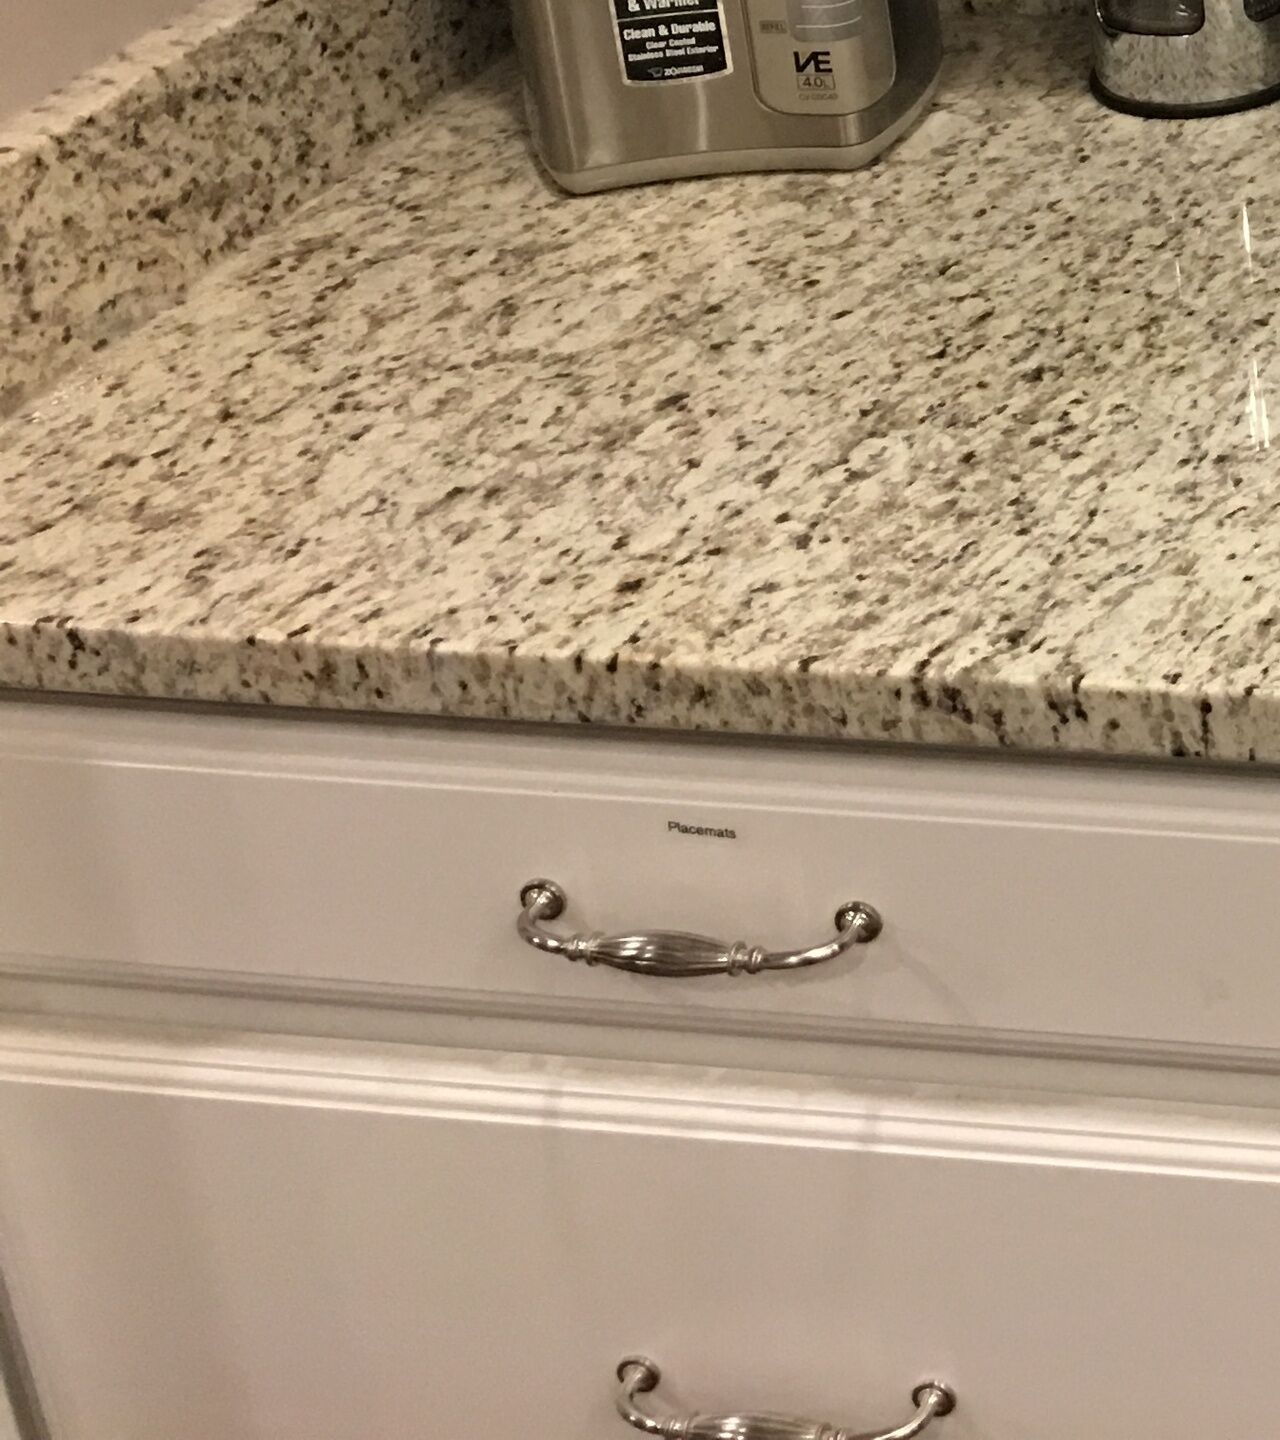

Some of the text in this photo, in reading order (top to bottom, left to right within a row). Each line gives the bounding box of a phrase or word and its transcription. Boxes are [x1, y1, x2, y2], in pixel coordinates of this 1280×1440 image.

[623, 21, 717, 40] Clean & Durable
[667, 821, 737, 839] Placemats
